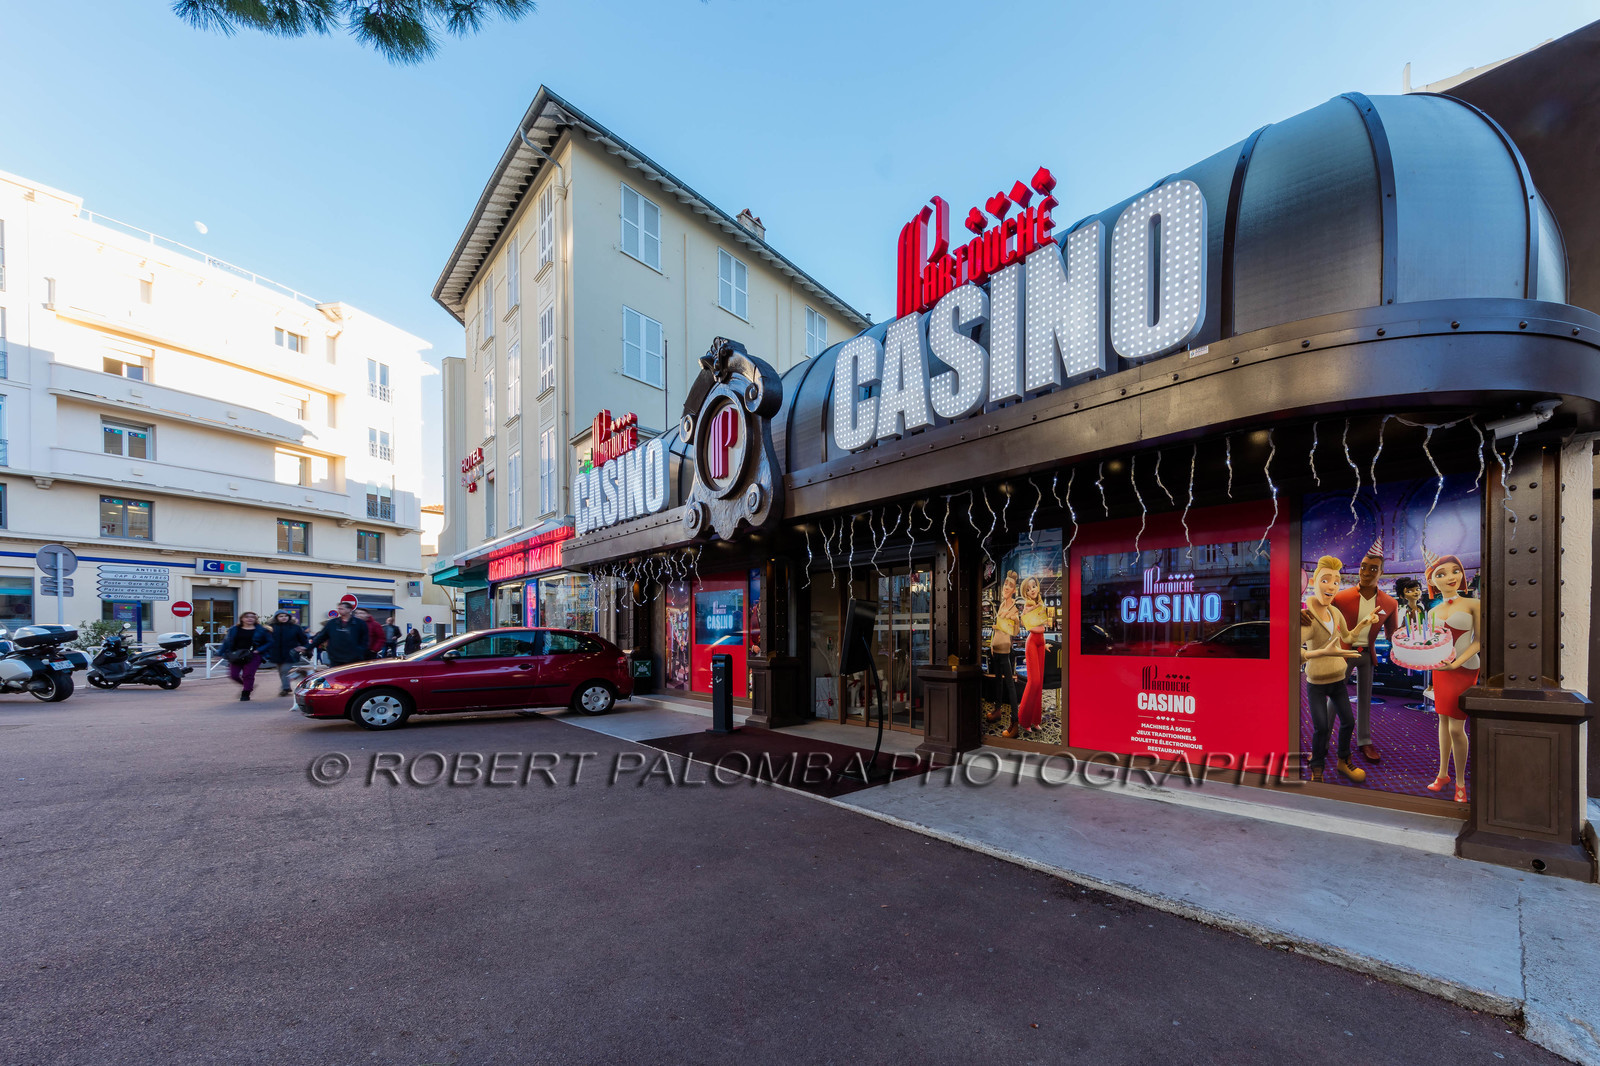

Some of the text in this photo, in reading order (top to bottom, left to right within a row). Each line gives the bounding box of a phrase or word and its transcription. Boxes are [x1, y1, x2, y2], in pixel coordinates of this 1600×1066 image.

[834, 179, 1208, 451] CASINO
[461, 447, 484, 473] HOTEL
[574, 438, 669, 534] CASINO
[206, 562, 238, 572] CIC
[1121, 592, 1222, 623] CASINO
[706, 615, 733, 630] CASINO
[1137, 692, 1196, 714] CASINO
[1141, 723, 1170, 731] MACHINES
[1131, 736, 1203, 750] ROULETTE ÉLECTRONIQUE
[1151, 731, 1197, 741] TRADITIONNELS
[1147, 746, 1185, 755] RESTAURANT
